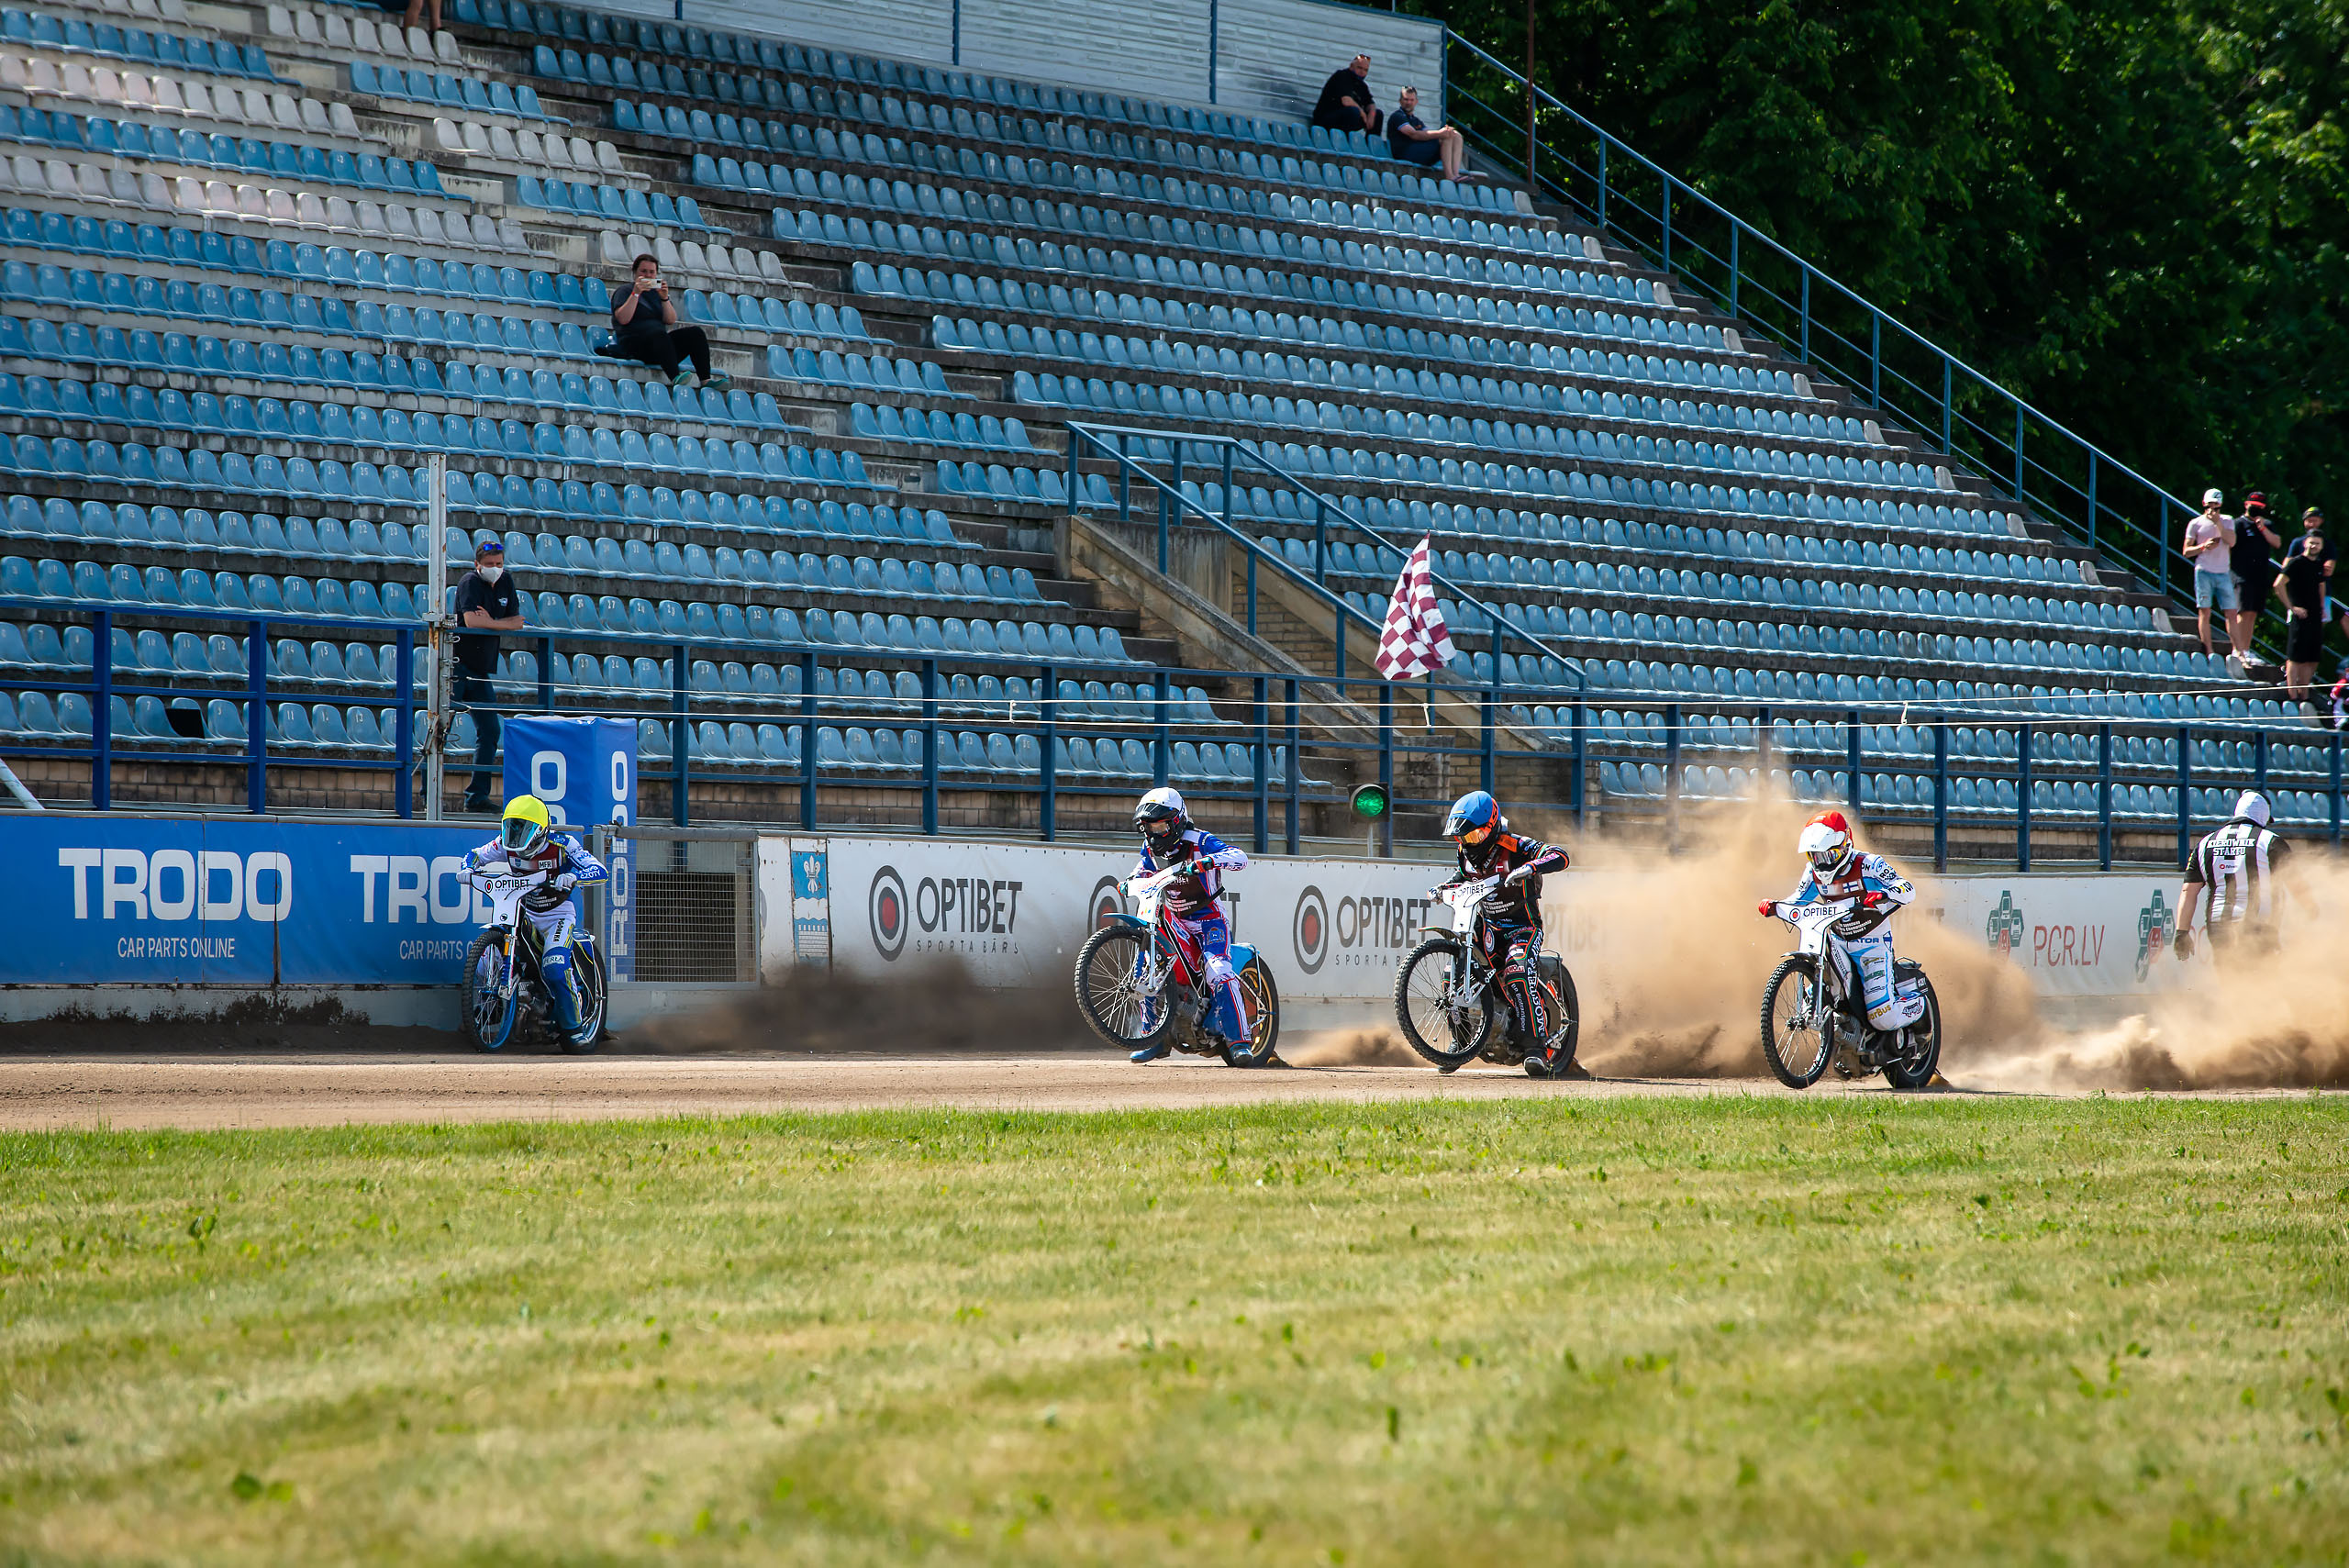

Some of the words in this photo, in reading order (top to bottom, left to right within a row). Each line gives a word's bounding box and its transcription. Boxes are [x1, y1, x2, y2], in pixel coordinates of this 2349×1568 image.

[2206, 838, 2256, 849] KIEROWNIK
[2212, 846, 2247, 857] STARTU
[539, 860, 551, 869] MFR
[59, 848, 292, 922] TRODO
[351, 855, 507, 924] TRO
[495, 879, 530, 889] OPTIBET
[1457, 884, 1485, 897] OPTIBET
[916, 876, 1022, 934] OPTIBET
[1803, 906, 1837, 917] OPTIBET
[1336, 895, 1431, 948] OPTIBET
[117, 937, 144, 958] CAR
[149, 937, 188, 958] PARTS
[190, 938, 235, 958] ONLINE
[399, 940, 424, 960] CAR
[427, 940, 463, 961] PARTS
[917, 940, 974, 952] SPORTA
[2033, 925, 2105, 966] PCR.LV
[1336, 954, 1387, 966] SPORTA
